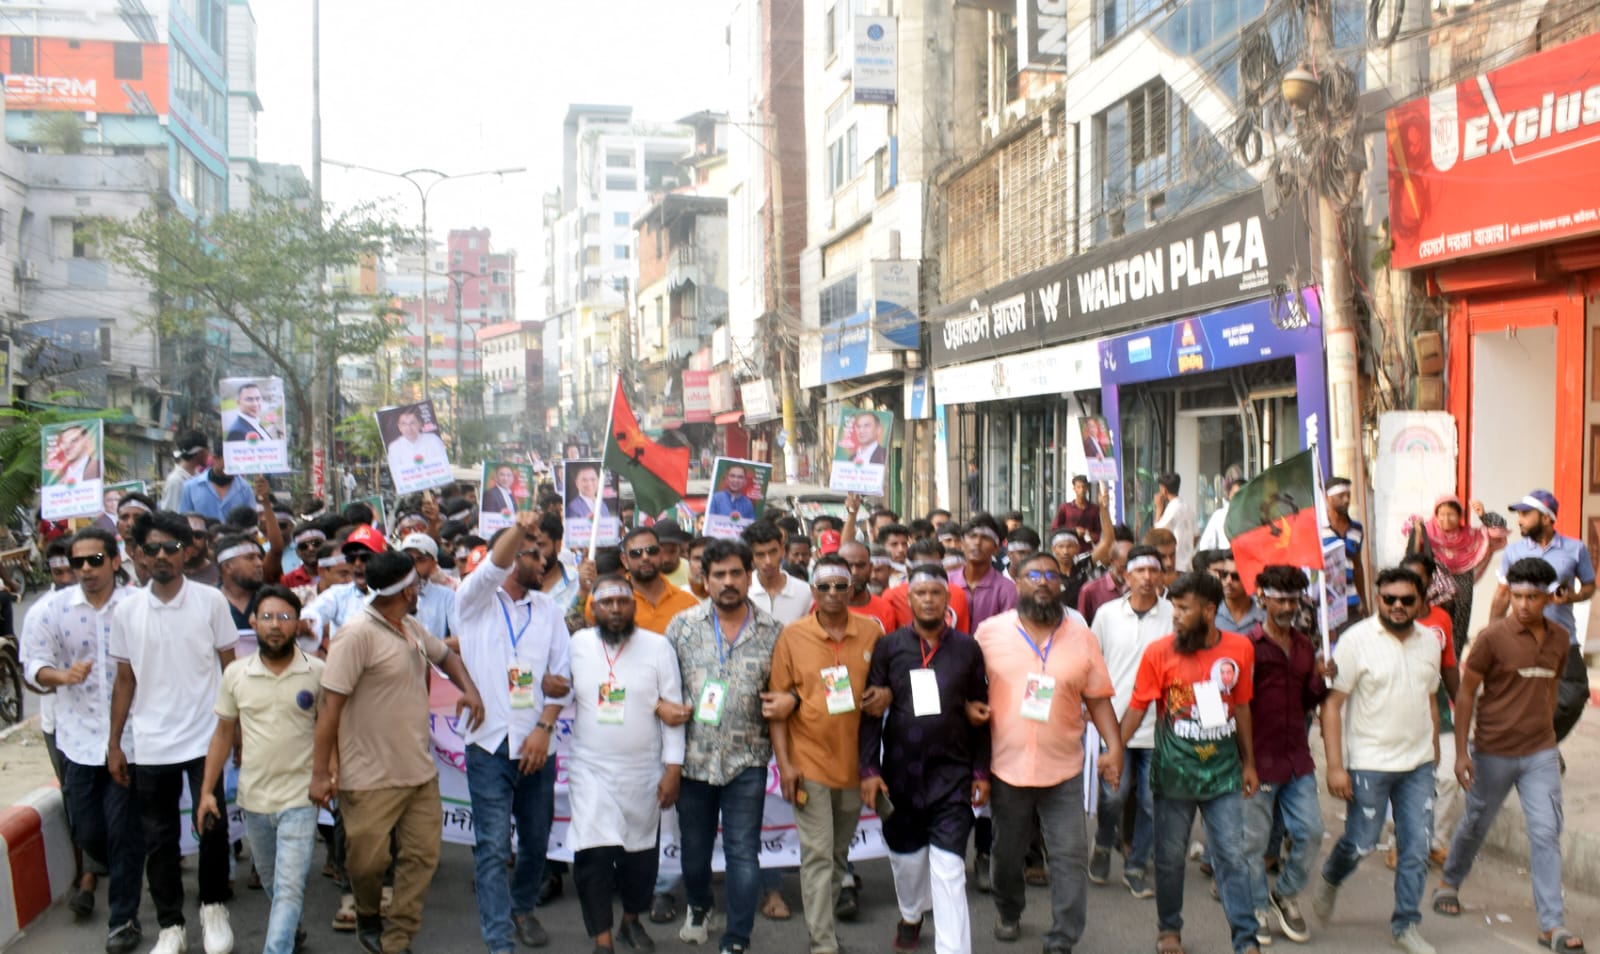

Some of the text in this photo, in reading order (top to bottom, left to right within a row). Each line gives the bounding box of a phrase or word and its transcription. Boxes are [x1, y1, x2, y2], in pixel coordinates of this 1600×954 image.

[1077, 216, 1268, 314] WALTON PLAZA
[943, 298, 989, 350] ওয়ালটন
